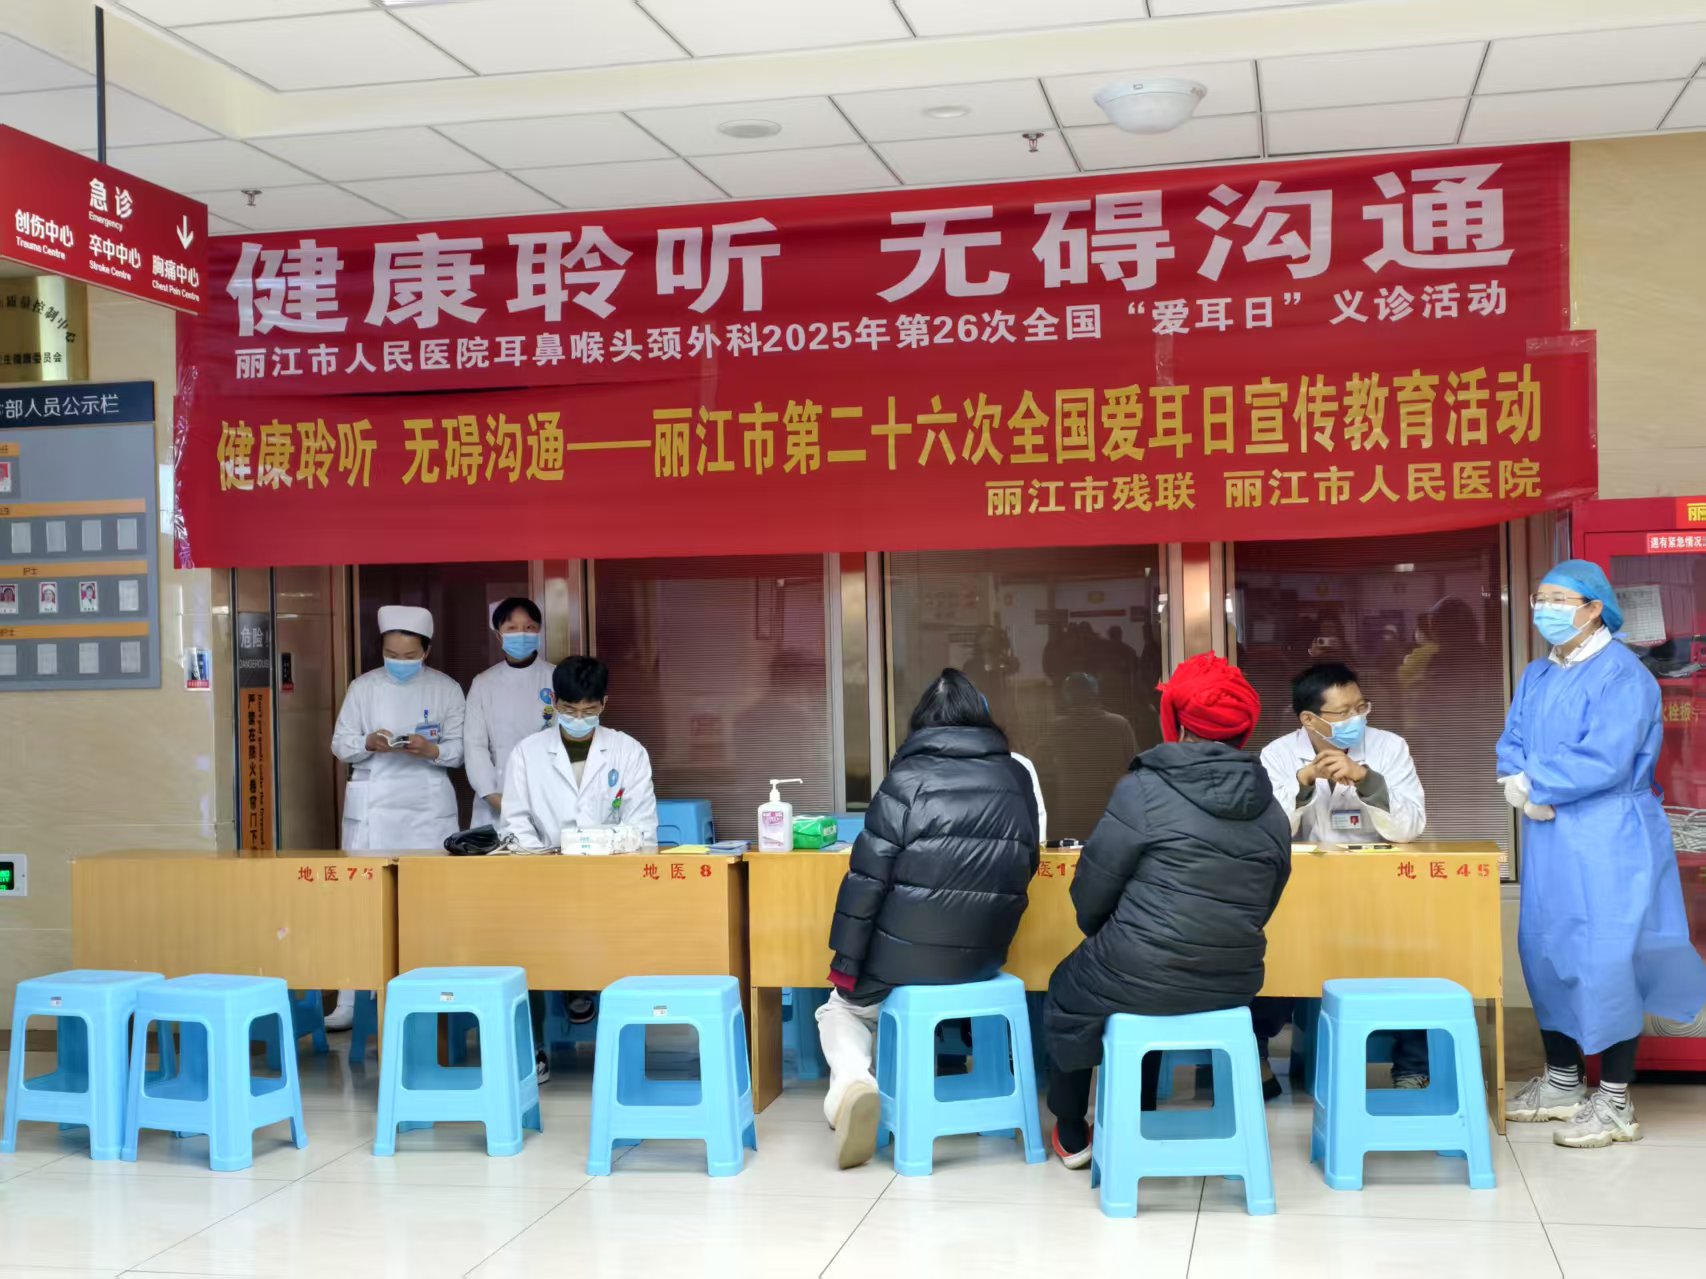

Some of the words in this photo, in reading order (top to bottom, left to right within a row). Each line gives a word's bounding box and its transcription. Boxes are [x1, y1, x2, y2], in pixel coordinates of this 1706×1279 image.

[88, 178, 134, 218] 急诊
[15, 209, 74, 247] 创伤中心
[88, 211, 123, 232] Emergency
[16, 236, 42, 253] Trauma
[42, 244, 66, 260] Centre
[88, 234, 142, 269] 卒中中心
[226, 218, 780, 336] 健康聆听
[876, 163, 1514, 303] 无碍沟通
[88, 259, 110, 274] Stroke
[110, 266, 132, 281] Centre
[152, 254, 200, 287] 胸痛中心
[216, 418, 378, 491] 健康聆听
[985, 472, 1196, 517] 丽江市残联
[1223, 457, 1542, 508] 丽江市人民医院
